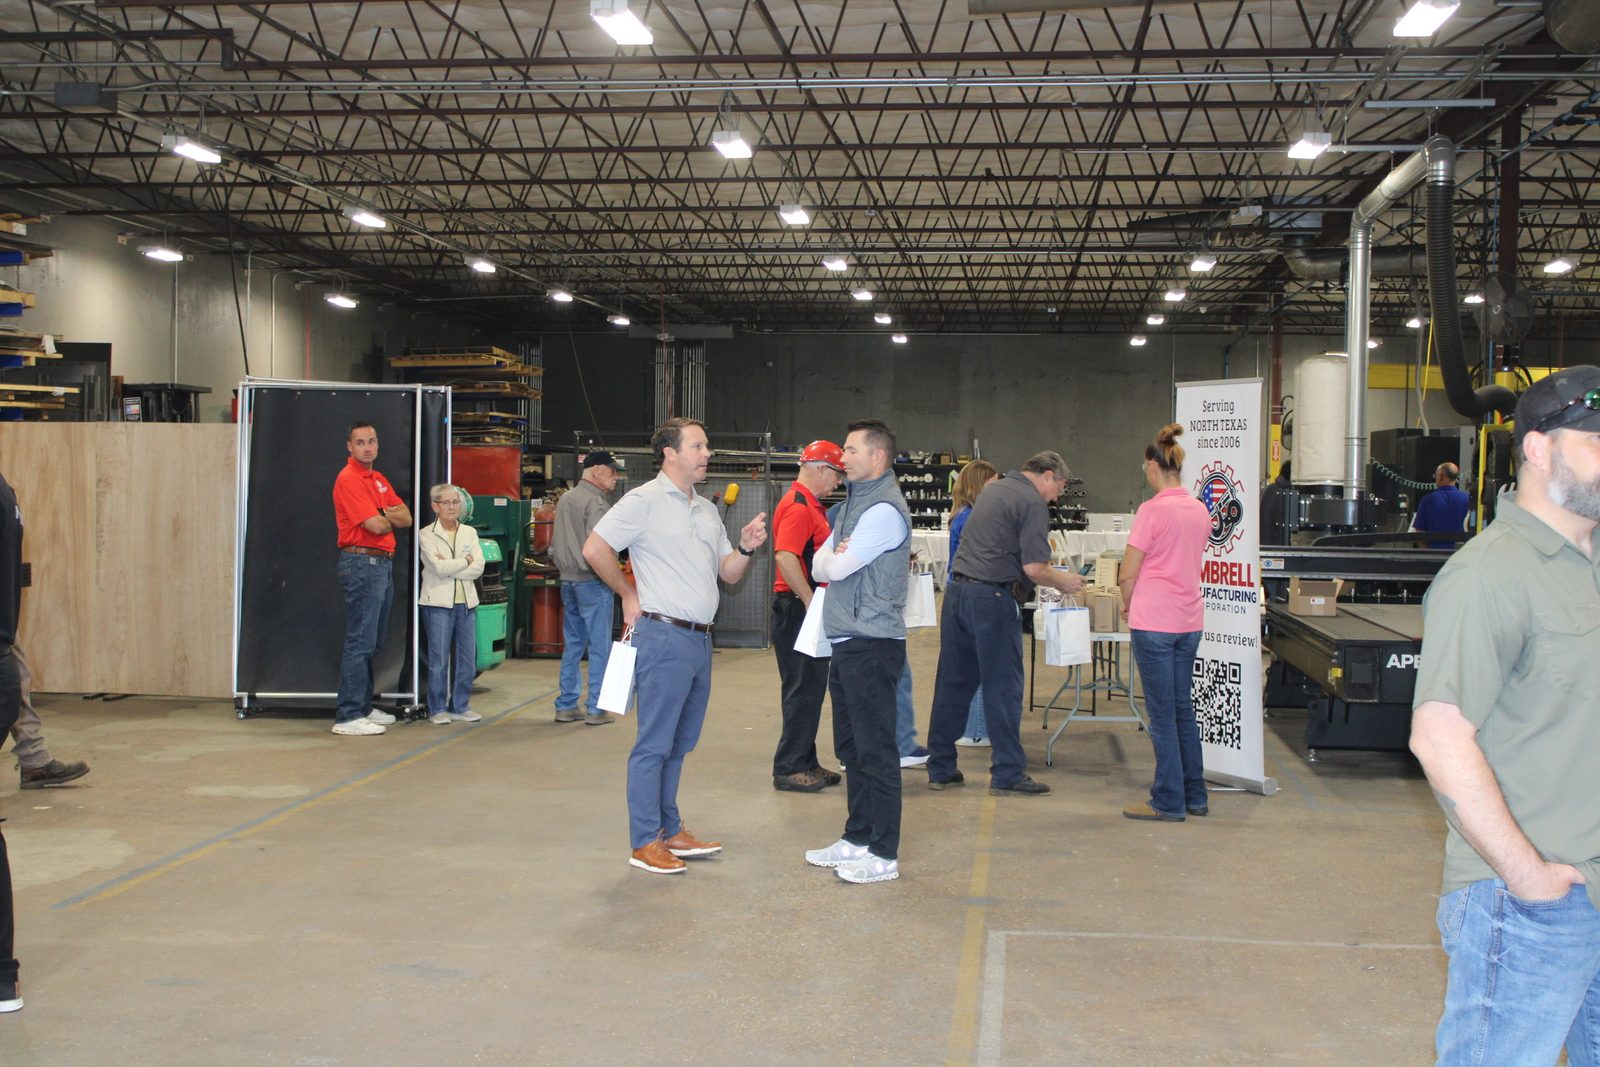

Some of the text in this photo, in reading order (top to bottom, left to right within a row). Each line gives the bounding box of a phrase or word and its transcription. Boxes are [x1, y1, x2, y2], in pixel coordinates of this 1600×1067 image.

[1202, 398, 1235, 415] Serving
[1190, 418, 1247, 431] NORTH TEXAS
[1197, 435, 1241, 448] since 2006
[1204, 631, 1258, 648] us a review!
